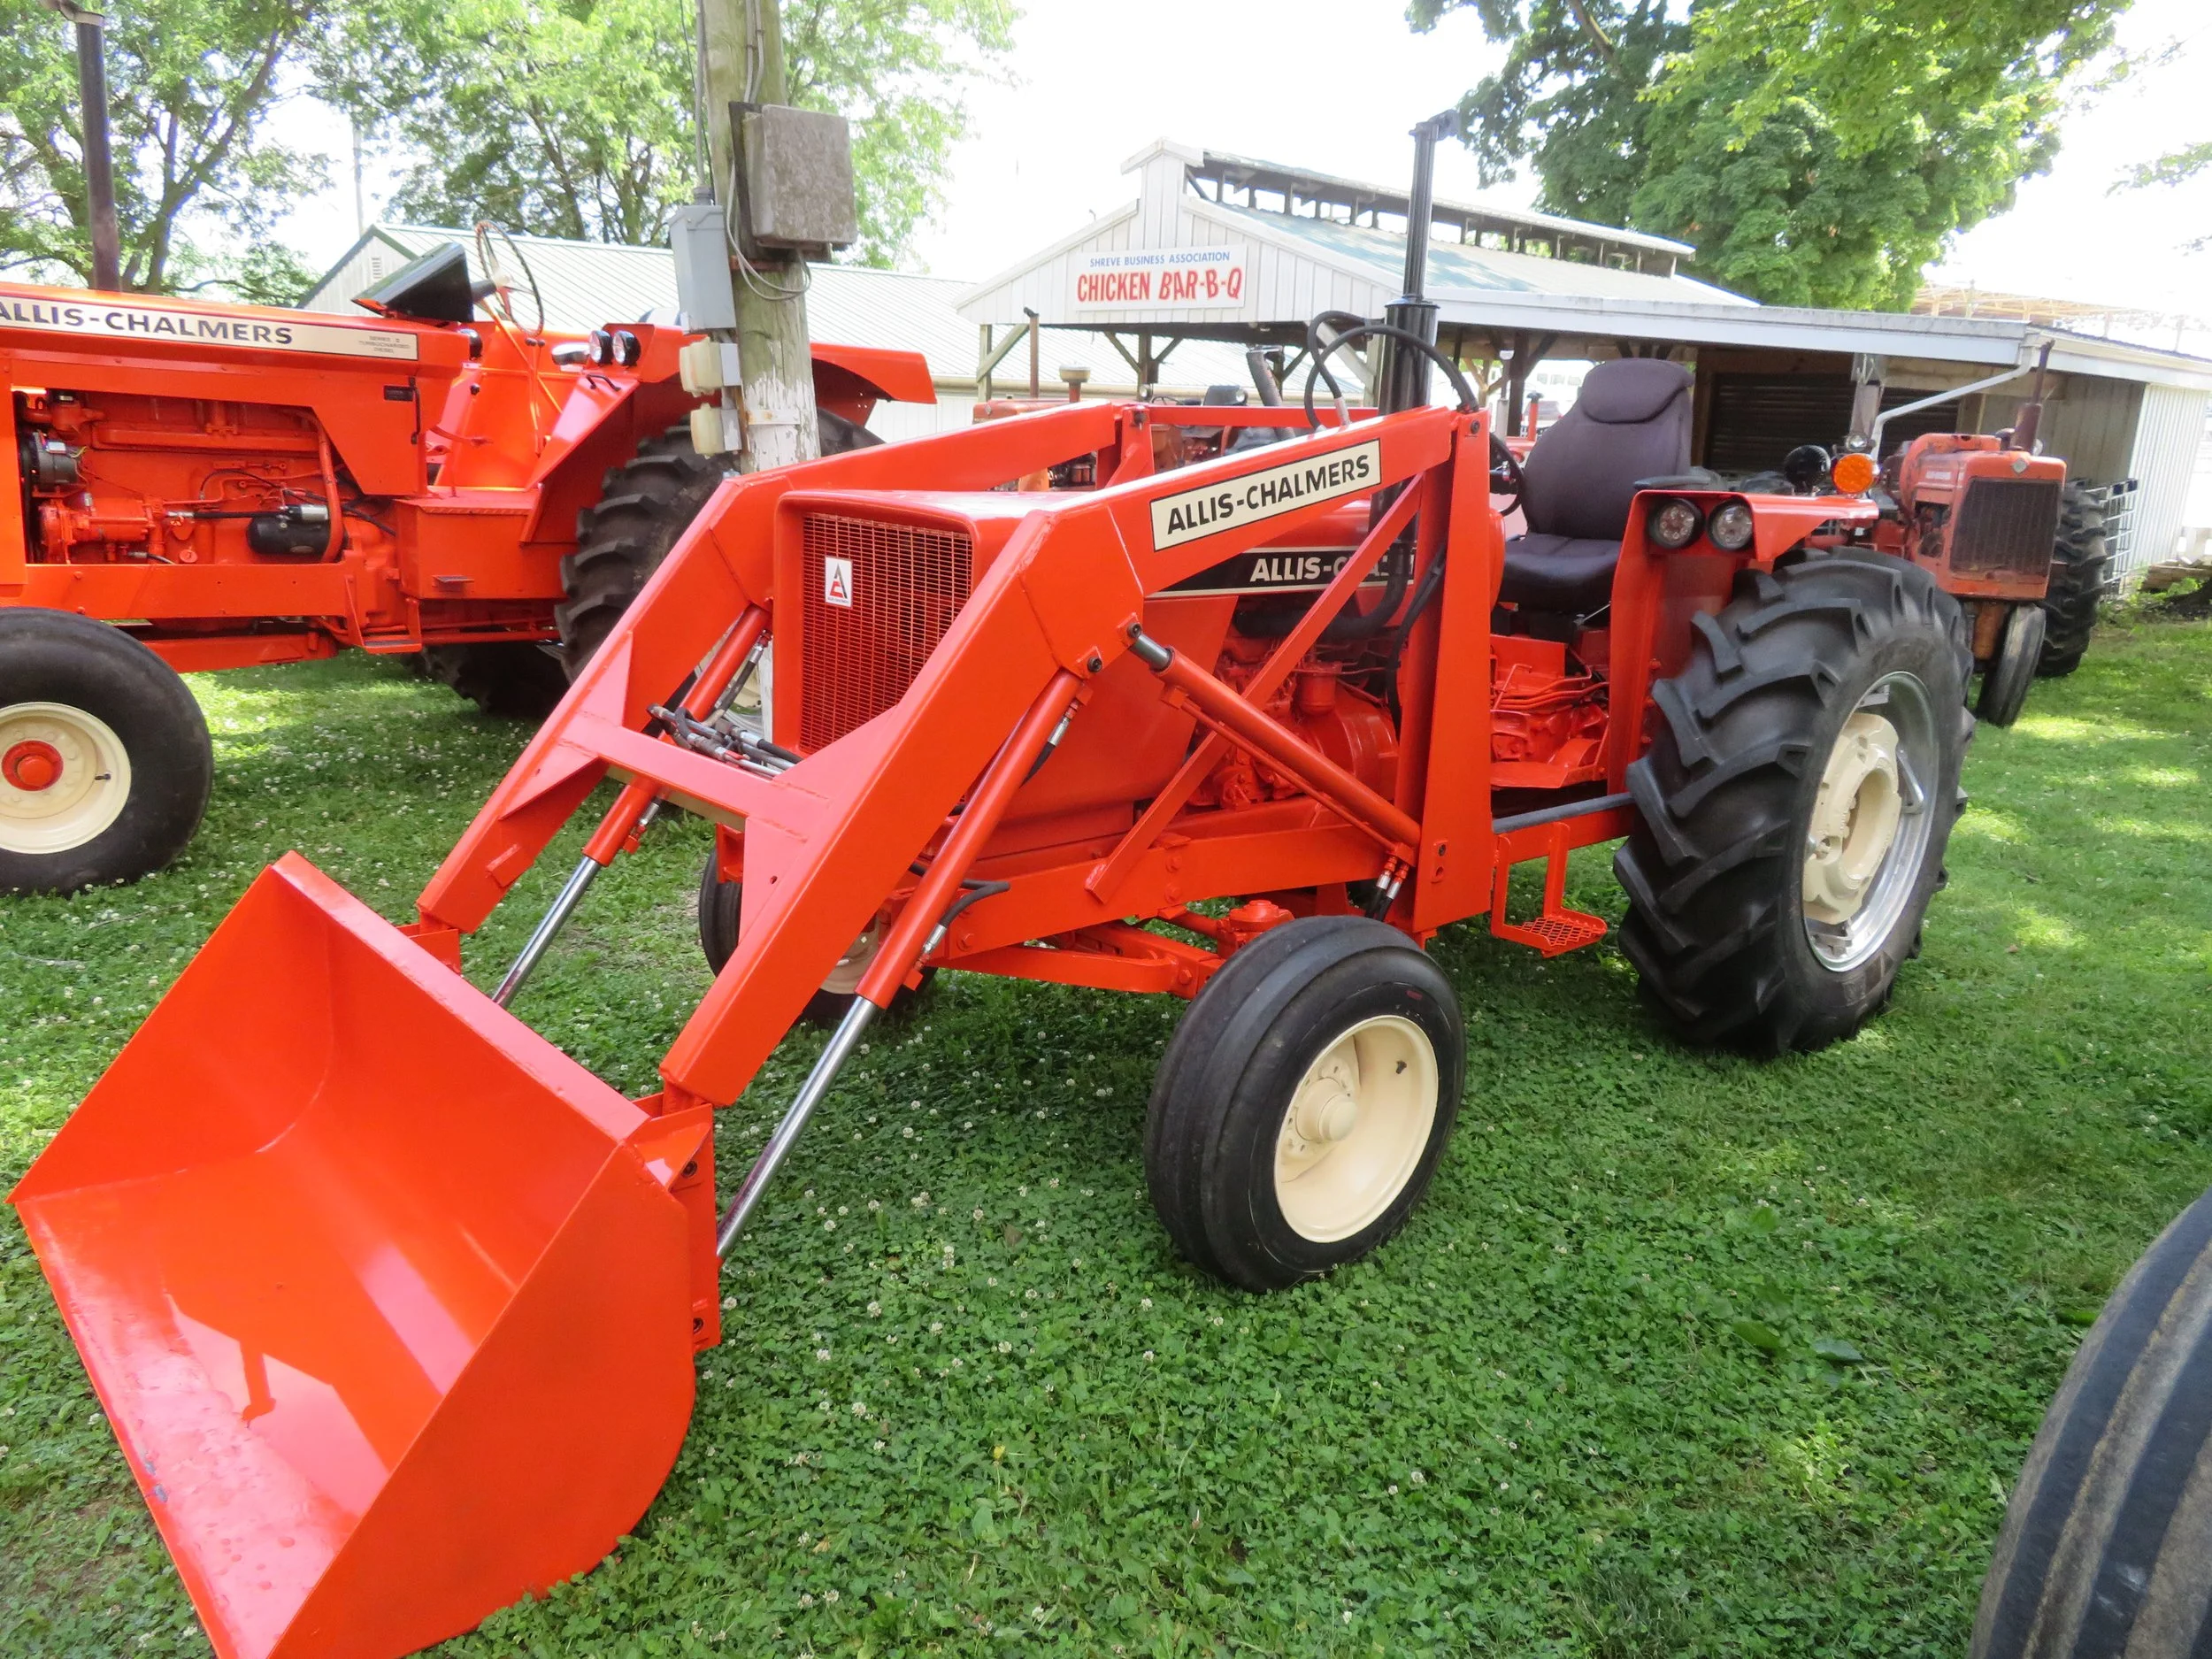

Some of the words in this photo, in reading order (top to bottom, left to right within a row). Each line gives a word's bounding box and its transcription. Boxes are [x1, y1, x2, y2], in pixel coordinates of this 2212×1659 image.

[1090, 257, 1121, 267] SHREVE
[1125, 254, 1165, 265] BUSINESS
[1169, 251, 1230, 264] ASSOCIATION
[1077, 271, 1150, 303] CHICKEN
[1158, 267, 1243, 301] BAR-B-Q
[1167, 454, 1370, 534] ALLIS-CHALMERS
